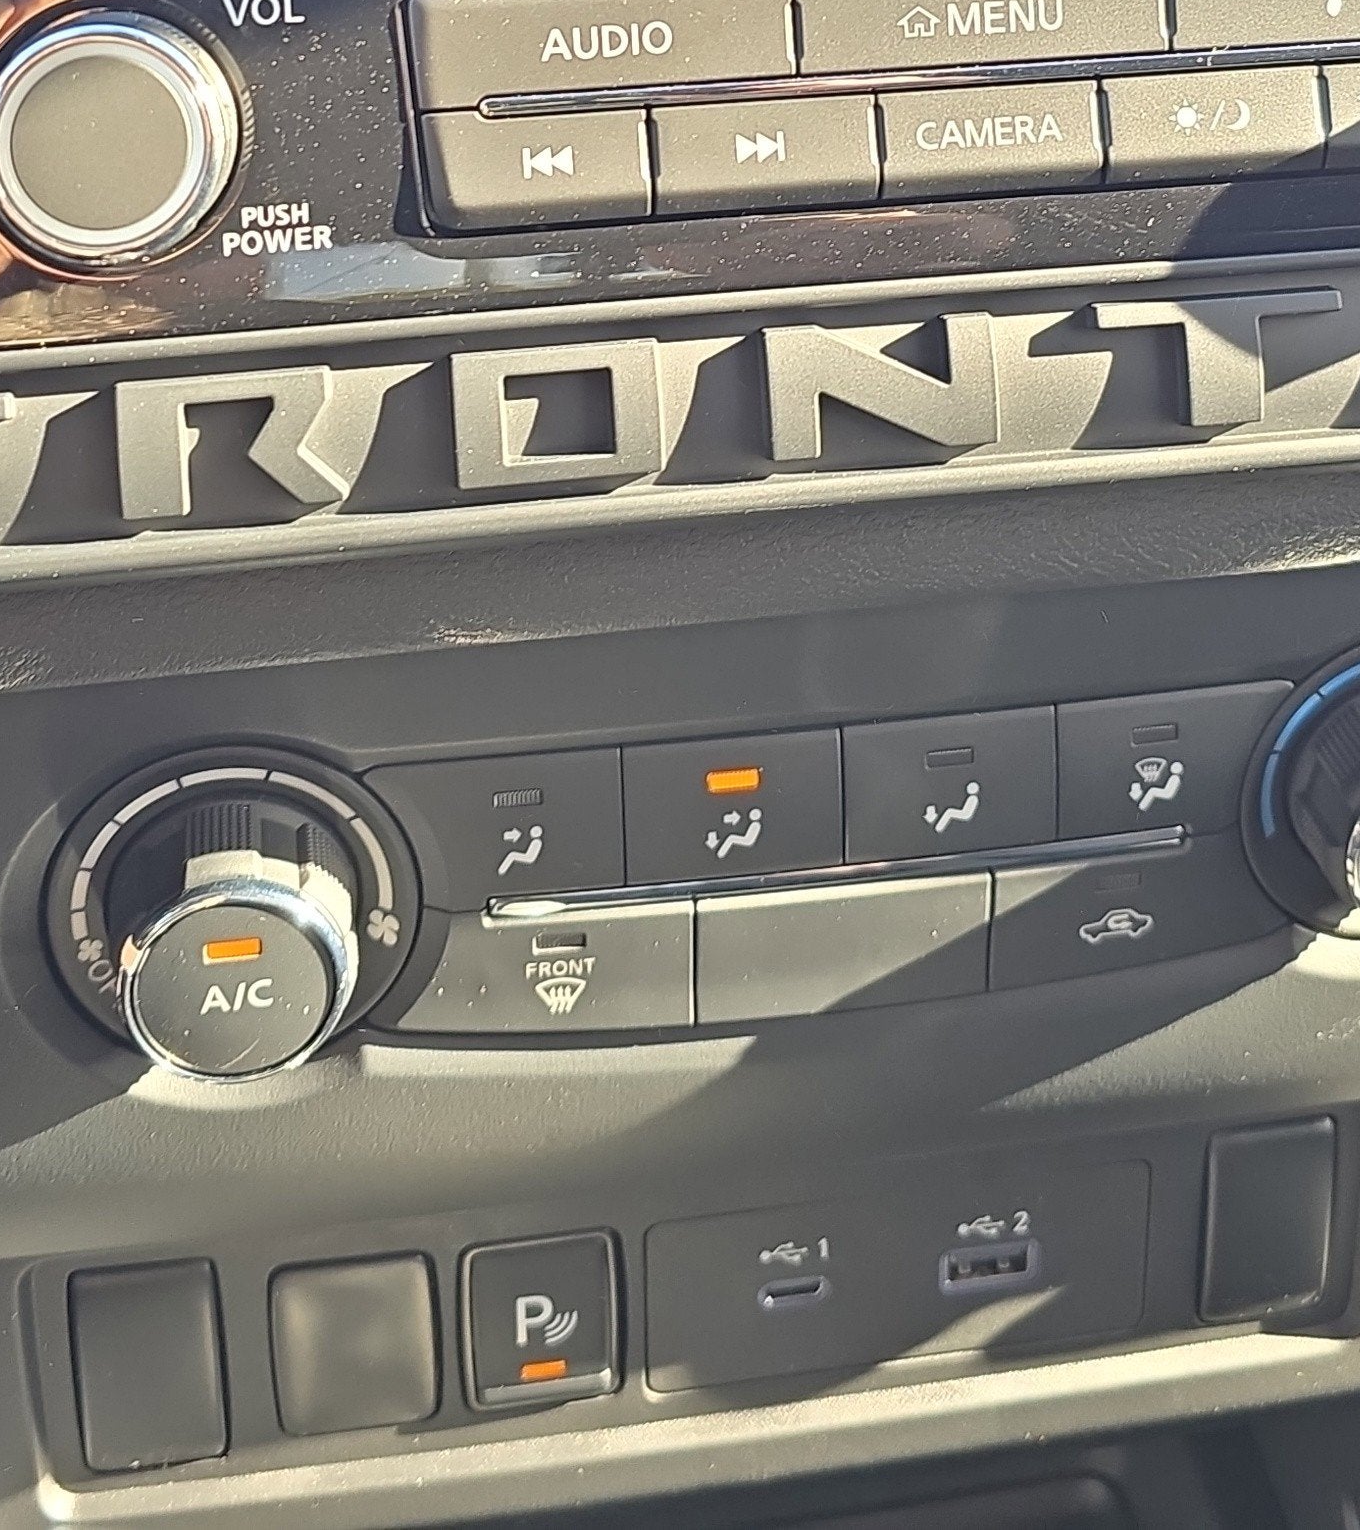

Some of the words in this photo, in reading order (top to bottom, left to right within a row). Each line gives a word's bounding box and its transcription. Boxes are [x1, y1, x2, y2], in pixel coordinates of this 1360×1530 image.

[541, 20, 674, 62] AUDIO
[915, 113, 1063, 151] CAMERA
[241, 202, 310, 230] PUSH
[222, 225, 333, 257] POWER
[525, 956, 596, 980] FRONT
[200, 977, 274, 1016] A/C
[1013, 1210, 1031, 1233] 2
[817, 1237, 830, 1259] 1
